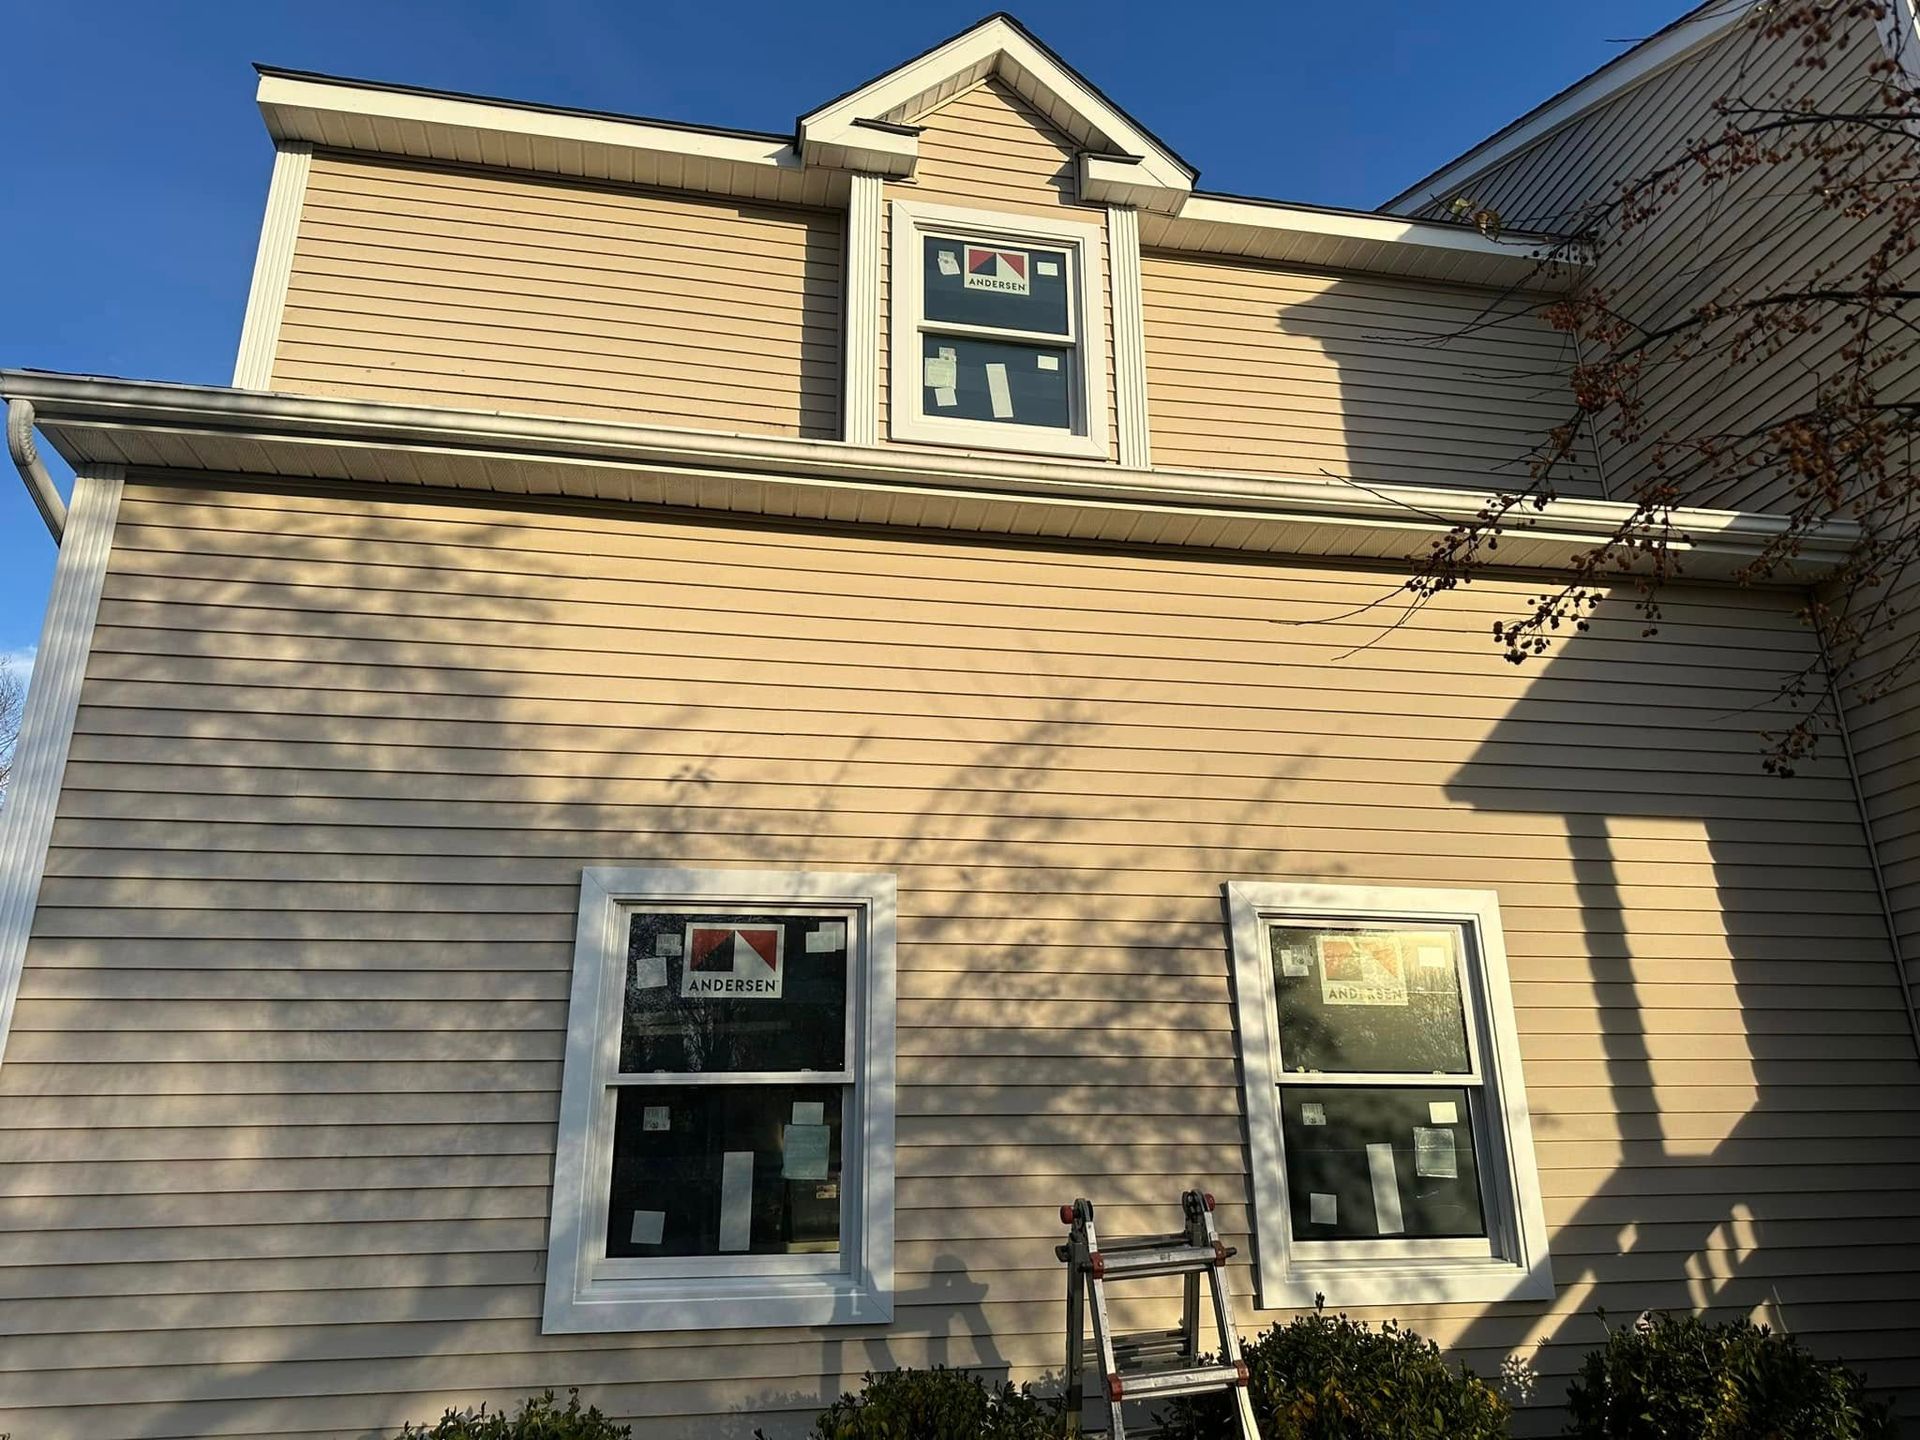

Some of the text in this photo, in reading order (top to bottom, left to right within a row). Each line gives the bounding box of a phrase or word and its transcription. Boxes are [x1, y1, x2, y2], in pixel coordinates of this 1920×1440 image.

[969, 278, 1025, 291] ANDERSEN
[689, 979, 776, 992] ANDERSEN
[1328, 987, 1402, 1000] ANDRSEN
